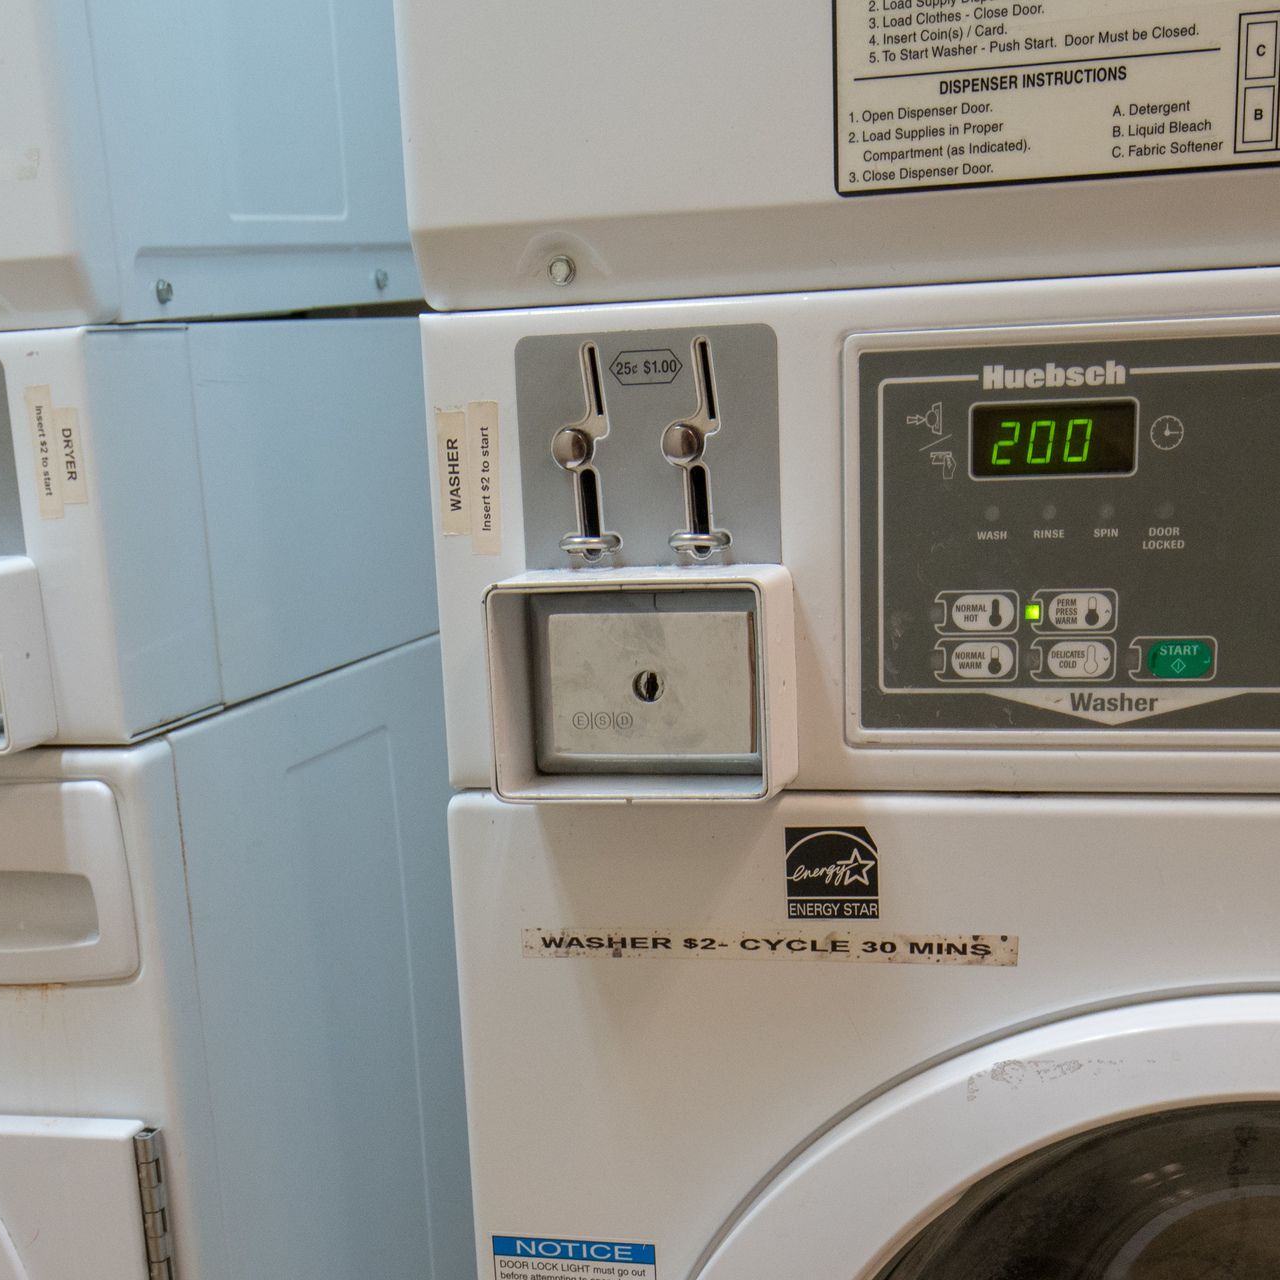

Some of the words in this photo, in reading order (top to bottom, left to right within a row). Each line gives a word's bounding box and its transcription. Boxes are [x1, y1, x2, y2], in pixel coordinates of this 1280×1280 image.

[1256, 44, 1266, 57] C
[939, 74, 1018, 95] DISPENSER
[1022, 65, 1127, 89] INSTRUCTIONS
[1112, 104, 1125, 117] A.
[1128, 100, 1191, 119] Detergent
[1254, 108, 1264, 121] B
[1112, 125, 1124, 138] B.
[1128, 121, 1165, 141] Liquid
[1169, 119, 1212, 134] Bleach
[1111, 145, 1125, 159] C.
[1128, 143, 1166, 157] Fabric
[1170, 140, 1224, 154] Softener
[643, 359, 677, 375] $1.00
[982, 360, 1126, 390] Huebsch
[35, 405, 46, 438] Insert
[40, 440, 49, 454] $2
[479, 426, 490, 457] start
[991, 418, 1093, 465] 200
[61, 428, 78, 481] DRYER
[41, 456, 49, 468] to
[481, 460, 490, 473] to
[446, 438, 462, 512] WASHER
[43, 470, 53, 496] start
[480, 476, 490, 492] $2
[481, 495, 492, 531] Insert
[976, 530, 1008, 540] WASH
[1033, 529, 1065, 539] RINSE
[1093, 528, 1119, 538] SPIN
[1148, 526, 1180, 537] DOOR
[1142, 539, 1185, 550] LOCKED
[955, 603, 987, 613] NORMAL
[1056, 598, 1077, 607] PERM
[963, 613, 978, 623] HOT
[1055, 607, 1078, 616] PRESS
[1055, 616, 1078, 625] WARM
[954, 651, 986, 660] NORMAL
[1051, 650, 1086, 659] DELICATES
[1159, 644, 1199, 656] START
[958, 661, 982, 670] WARM
[1058, 660, 1077, 669] COLD
[1070, 692, 1159, 712] Washer
[789, 902, 841, 916] ENERGY
[843, 902, 878, 916] STAR
[541, 936, 672, 950] WASHER
[739, 938, 850, 954] CYCLE
[861, 940, 897, 954] 30
[908, 941, 993, 957] MINS
[516, 1239, 633, 1261] NOTICE
[499, 1259, 529, 1270] DOOR
[531, 1261, 559, 1272] LOCK
[560, 1263, 591, 1273] LIGHT
[593, 1267, 616, 1275] must
[617, 1268, 629, 1278] go
[631, 1268, 646, 1277] out
[500, 1270, 528, 1280] before
